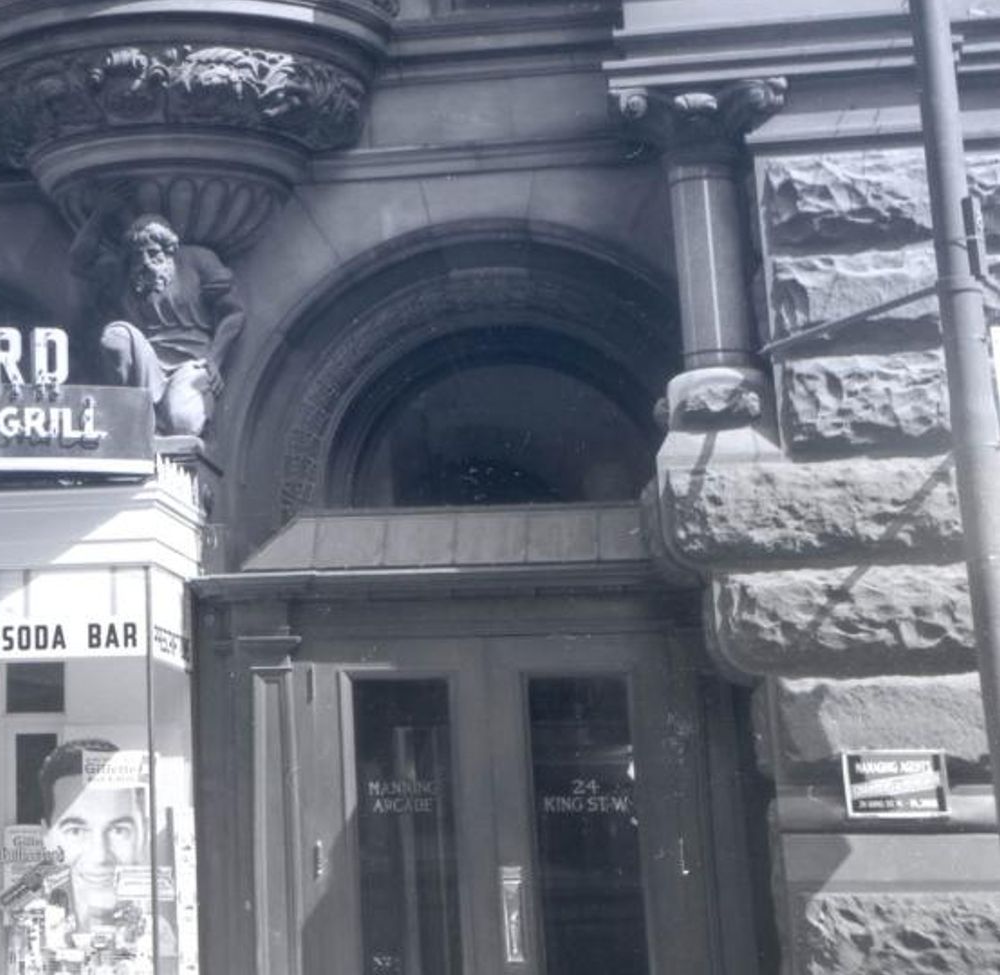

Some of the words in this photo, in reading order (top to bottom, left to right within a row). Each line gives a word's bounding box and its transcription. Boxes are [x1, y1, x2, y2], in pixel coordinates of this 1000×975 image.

[2, 624, 67, 651] SODA
[87, 622, 138, 649] BAR
[368, 780, 437, 797] MANNING
[572, 779, 600, 795] 24
[373, 798, 433, 814] ARCADE
[544, 796, 583, 812] KING
